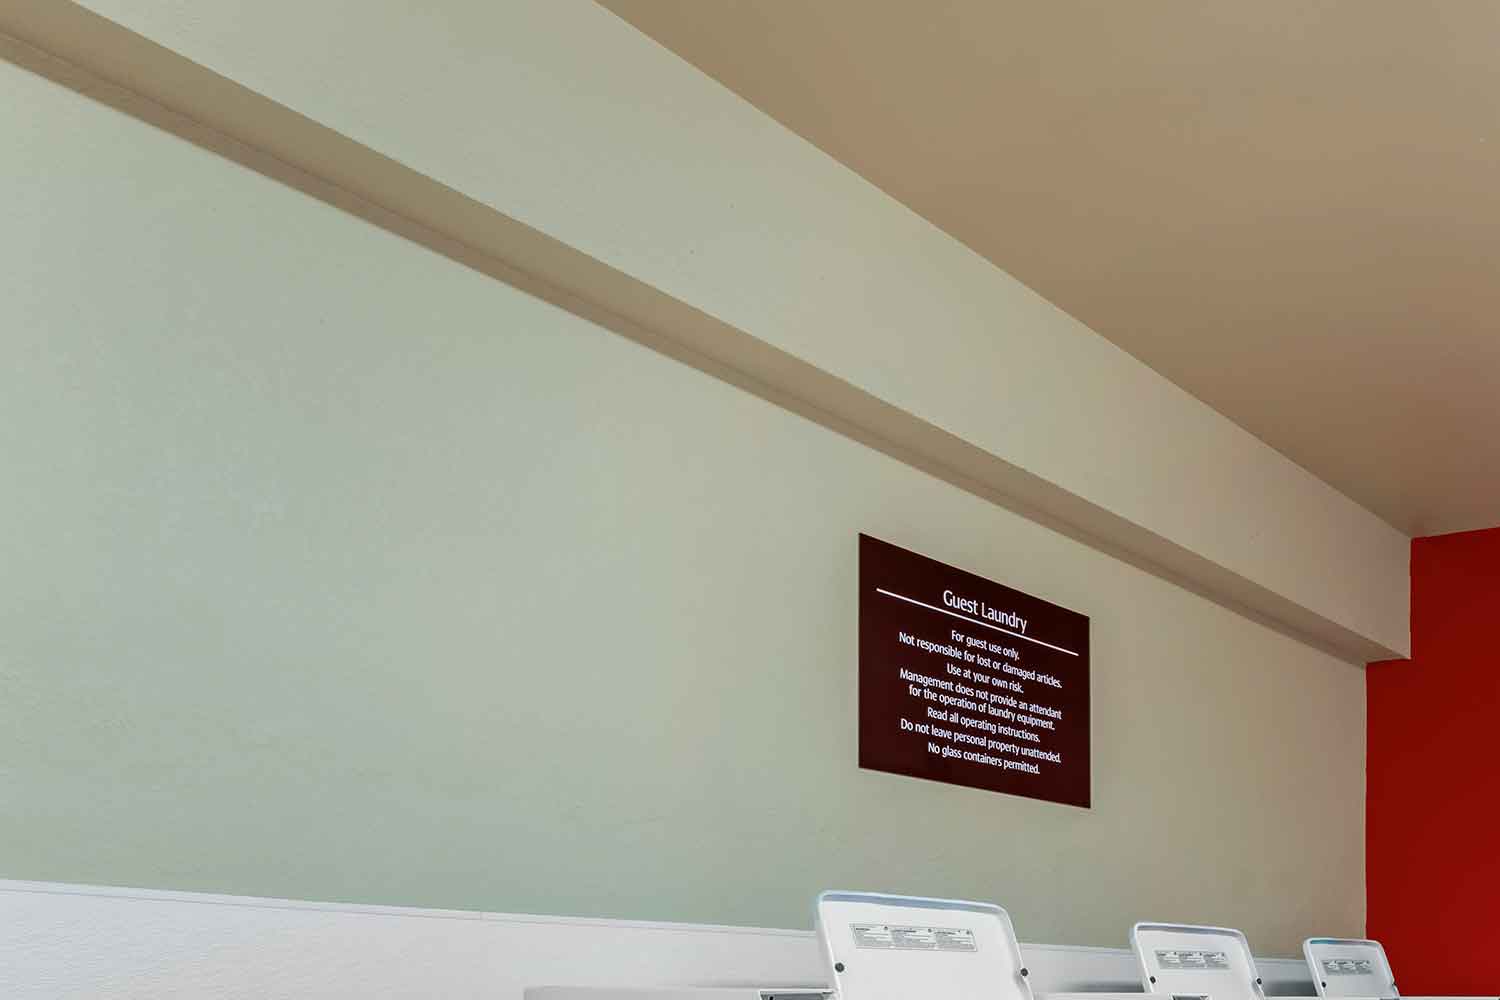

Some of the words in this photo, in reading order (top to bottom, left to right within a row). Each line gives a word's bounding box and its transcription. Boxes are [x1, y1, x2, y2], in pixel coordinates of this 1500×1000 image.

[943, 589, 979, 616] Guest
[981, 602, 1027, 634] Laundry
[899, 631, 916, 647] Not
[916, 639, 962, 660] responsible
[963, 650, 976, 663] for
[976, 653, 992, 668] lost
[992, 661, 1001, 671] or
[1002, 662, 1036, 681] damaged
[1036, 673, 1063, 689] articles.
[951, 629, 965, 643] For
[966, 636, 987, 651] guest
[988, 643, 1002, 654] use
[1002, 648, 1020, 661] only.
[900, 667, 954, 692] Management
[955, 682, 975, 697] does
[975, 689, 989, 701] not
[989, 695, 1018, 709] provide
[1018, 701, 1028, 712] an
[1028, 703, 1063, 720] attendant
[946, 662, 962, 676] Use
[962, 669, 972, 680] at
[972, 671, 991, 684] your
[991, 677, 1008, 689] own
[1008, 680, 1025, 694] risk.
[908, 684, 922, 697] for
[923, 688, 938, 701] the
[939, 694, 978, 712] operation
[978, 703, 987, 714] of
[987, 704, 1016, 722] laundry
[1016, 713, 1056, 731] equipment.
[927, 706, 948, 721] Read
[949, 711, 959, 724] all
[960, 716, 997, 735] operating
[997, 722, 1041, 743] instructions.
[900, 718, 914, 731] Do
[915, 723, 930, 735] not
[931, 724, 953, 740] leave
[953, 732, 987, 748] personal
[987, 739, 1020, 756] property
[1020, 746, 1062, 764] unattended.
[927, 742, 940, 754] No
[941, 745, 962, 759] glass
[963, 751, 1003, 767] containers
[1003, 759, 1041, 775] permitted.
